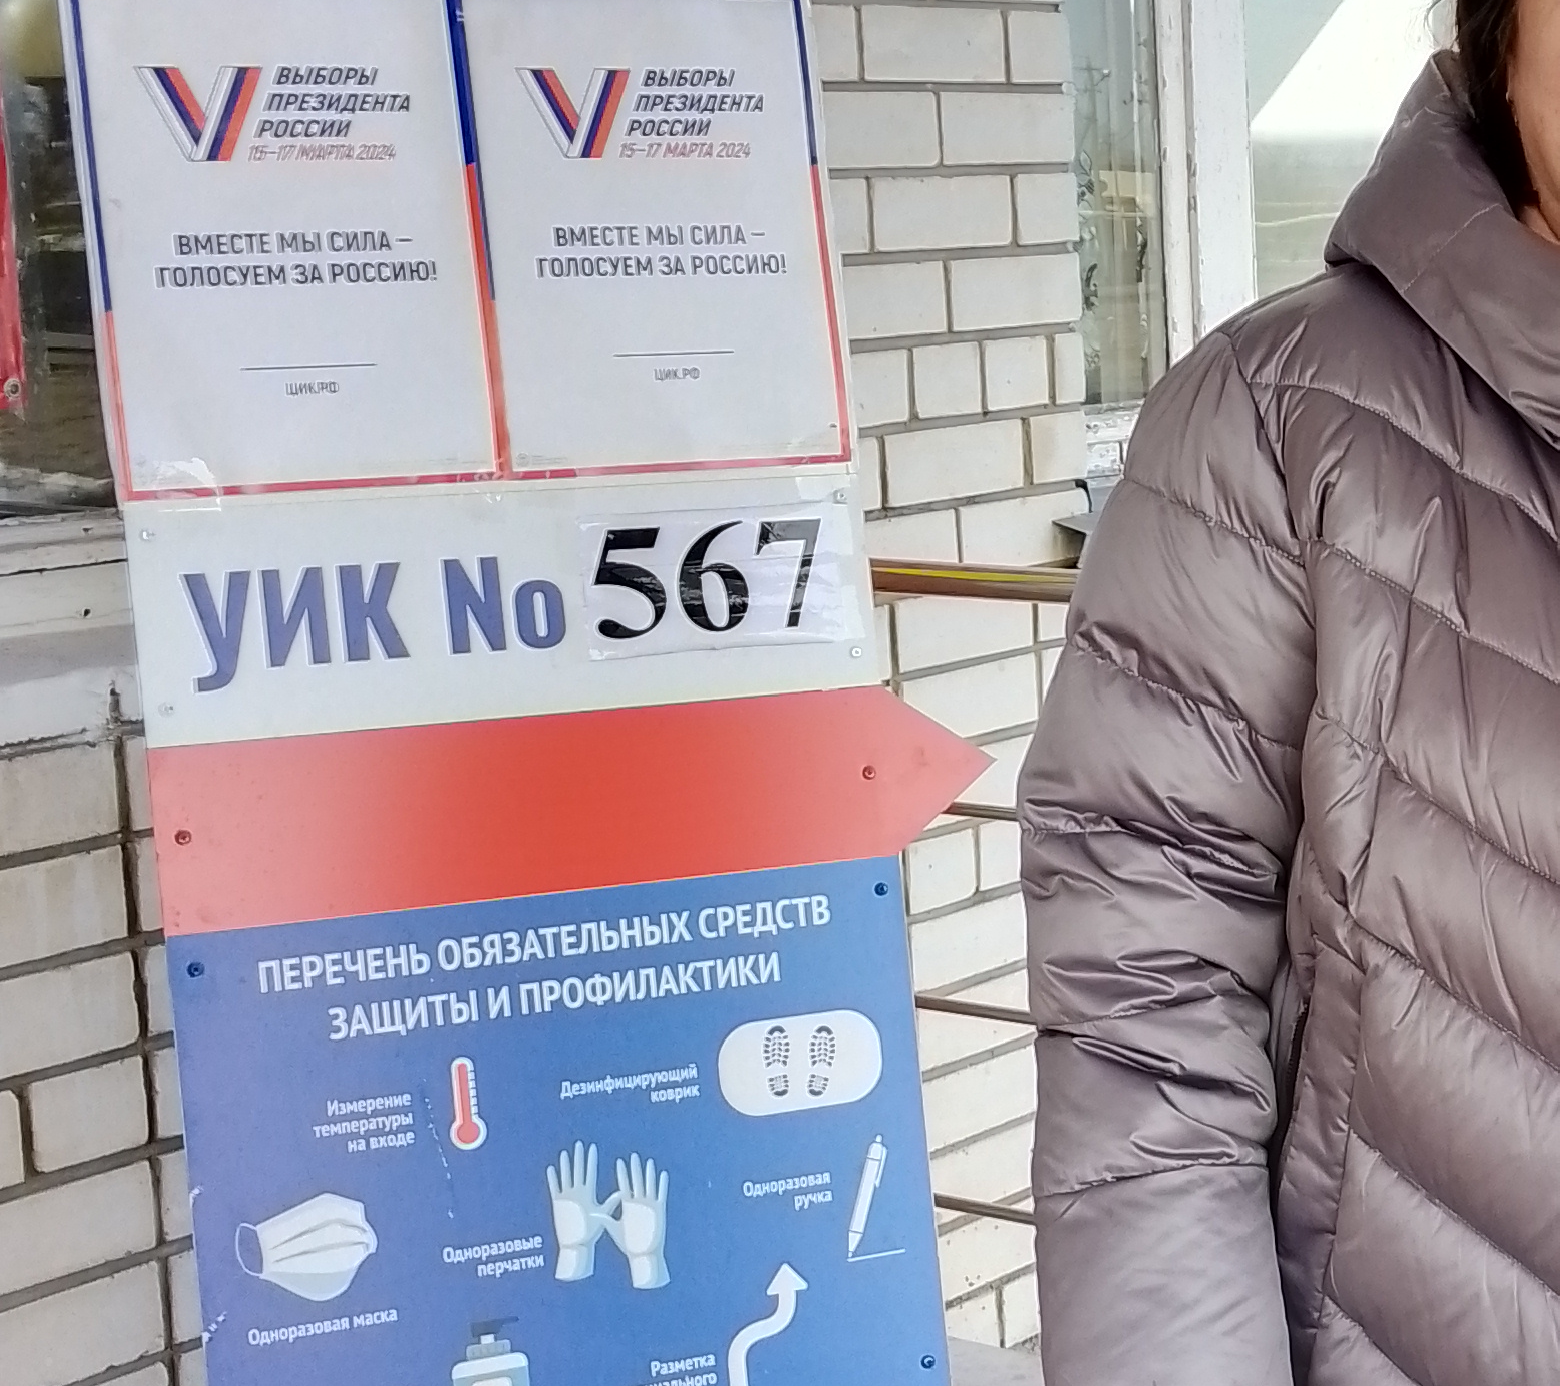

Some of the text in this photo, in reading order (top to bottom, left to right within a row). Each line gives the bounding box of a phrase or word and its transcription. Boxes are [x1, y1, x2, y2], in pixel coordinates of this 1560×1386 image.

[271, 65, 378, 86] ВЫБОРЫ
[641, 67, 736, 88] ВЫБОРЫ
[262, 91, 411, 113] ПРЕЗИДЕНТА
[633, 93, 764, 114] ПРЕЗИДЕНТА
[253, 118, 352, 139] РОССИИ
[625, 118, 712, 138] РОССИИ
[297, 144, 353, 161] МАРТА
[355, 143, 397, 161] 2024
[662, 142, 714, 158] МАРТА
[715, 142, 751, 159] 2024
[172, 232, 272, 256] ВМЕСТЕ
[275, 231, 322, 254] МЫ
[325, 229, 392, 252] СИЛА
[552, 225, 640, 247] ВМЕСТЕ
[645, 224, 684, 246] МЫ
[689, 223, 747, 245] СИЛА
[154, 260, 437, 288] ГОЛОСУЕМ ЗА РОССИЮ!
[536, 253, 787, 279] ГОЛОСУЕМ ЗА РОССИЮ!
[178, 560, 412, 694] УИК
[590, 516, 823, 641] 567
[257, 894, 831, 993] ПЕРЕЧЕНЬ ОБЯЗАТЕЛЬНЫХ СРЕДСТВ
[329, 951, 781, 1041] ЗАЩИТЫ И ПРОФИЛАКТИКИ
[560, 1063, 698, 1099] Дезинфицирующий
[650, 1084, 700, 1103] коврик
[326, 1092, 412, 1117] Измерение
[313, 1112, 414, 1140] температуры
[347, 1129, 415, 1153] на входе
[743, 1172, 831, 1198] Одноразовая
[794, 1189, 832, 1211] ручка
[443, 1234, 542, 1265] Одноразовые
[477, 1253, 544, 1278] перчатки
[248, 1307, 398, 1346] Одноразовая маска
[651, 1352, 716, 1377] Разметка
